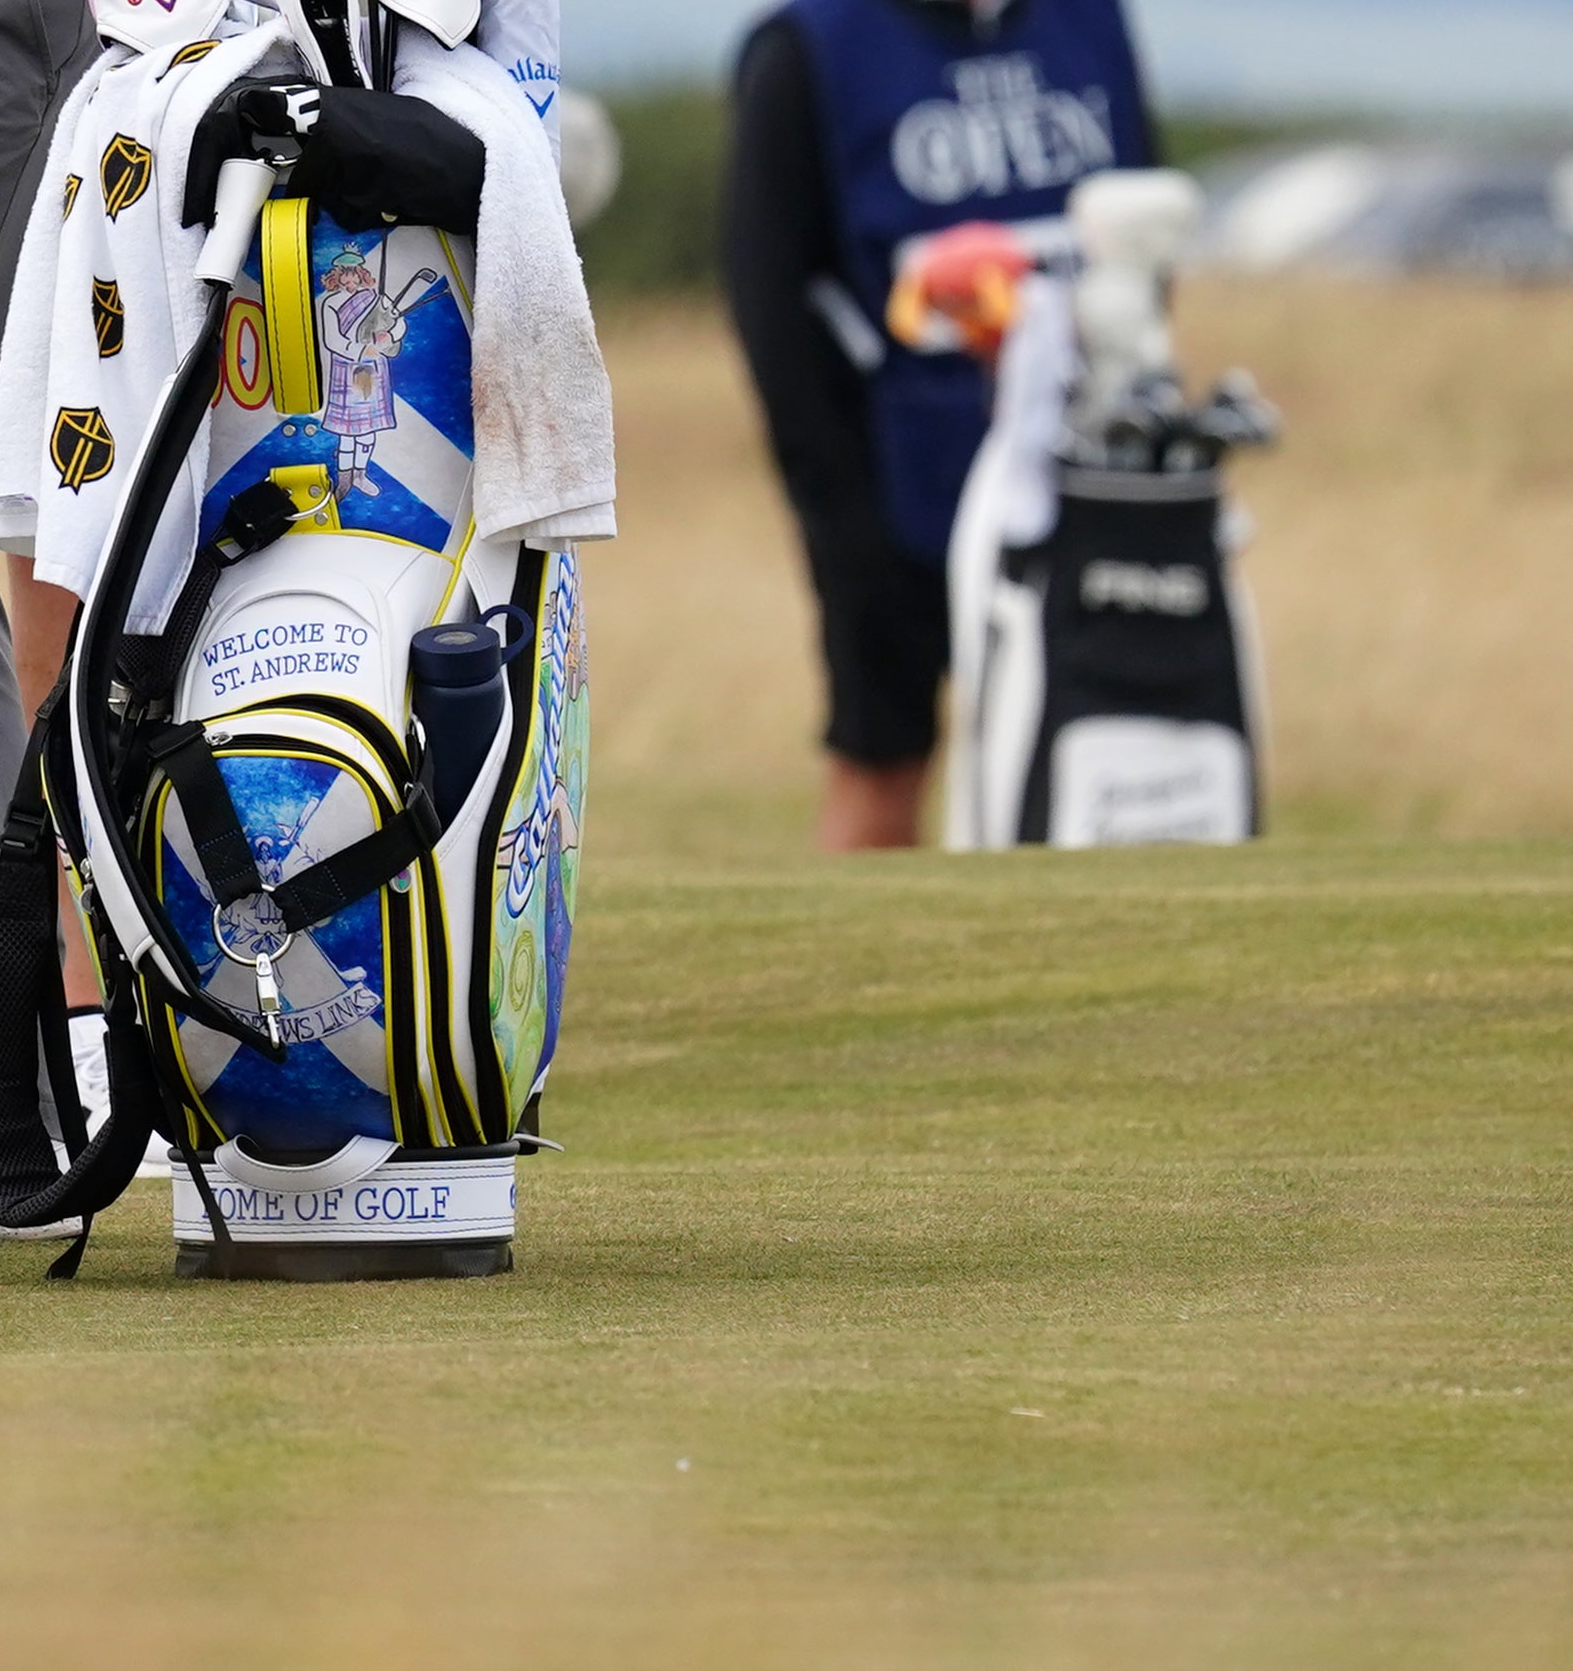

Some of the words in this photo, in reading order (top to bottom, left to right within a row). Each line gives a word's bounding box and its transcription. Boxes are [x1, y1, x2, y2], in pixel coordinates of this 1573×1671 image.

[202, 623, 324, 668] WELCOME
[335, 623, 368, 647] TO
[211, 667, 246, 697] ST.
[250, 652, 360, 684] ANDREWS
[316, 987, 379, 1033] LINKS
[295, 1188, 343, 1221] OF
[354, 1186, 450, 1221] GOLF
